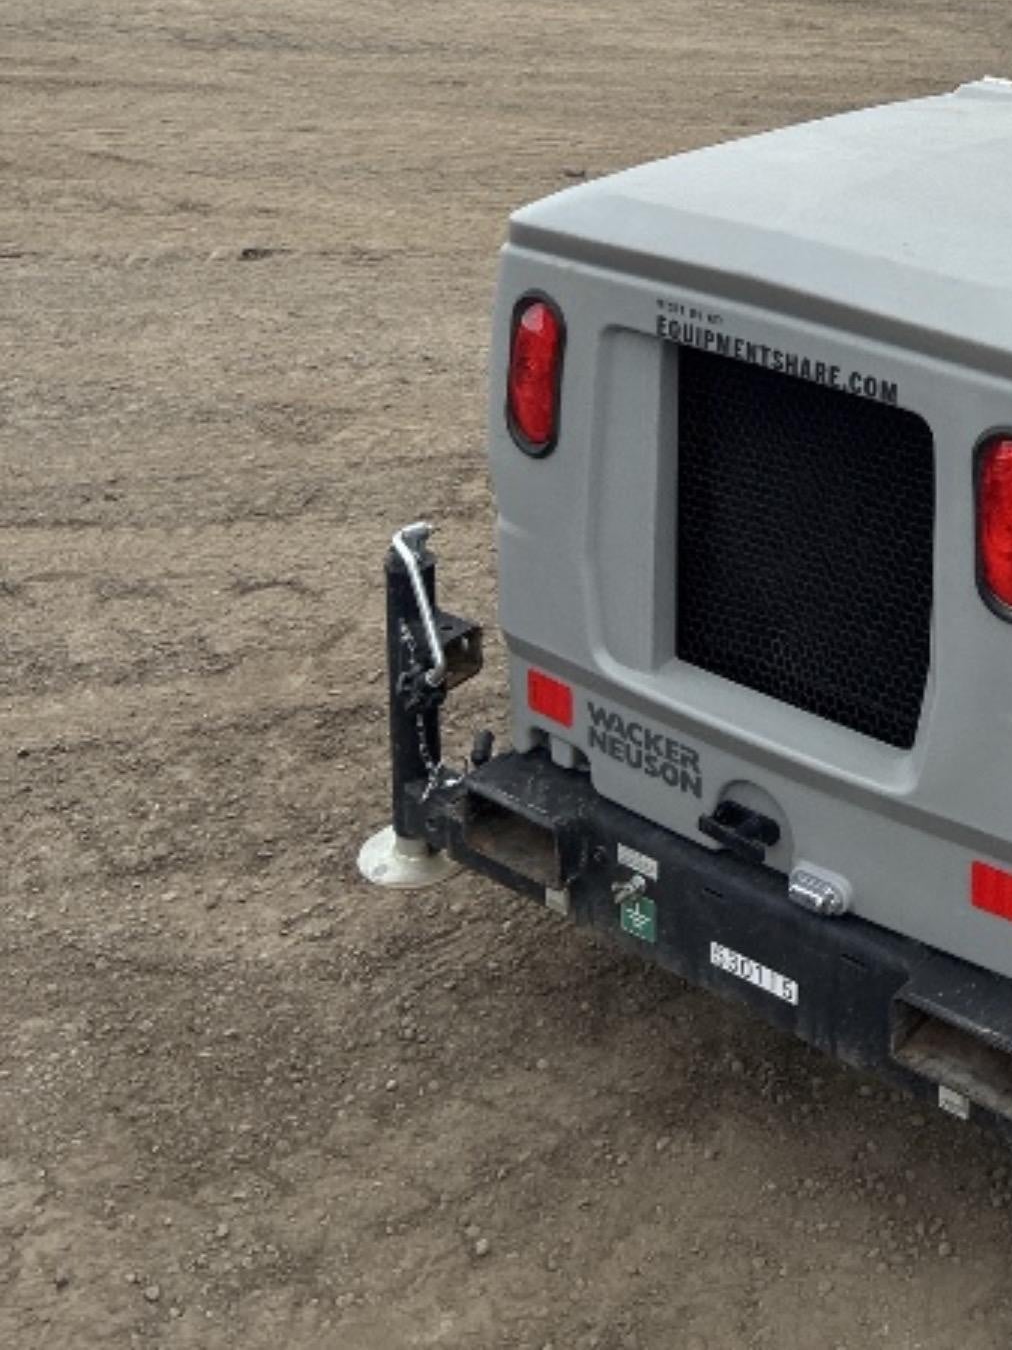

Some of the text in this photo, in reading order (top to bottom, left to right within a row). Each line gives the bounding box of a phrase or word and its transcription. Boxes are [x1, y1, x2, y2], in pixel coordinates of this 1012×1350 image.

[656, 314, 899, 404] EQUIPMENTSHARE.COM
[586, 701, 702, 776] WACKER
[587, 724, 703, 800] NEUSON
